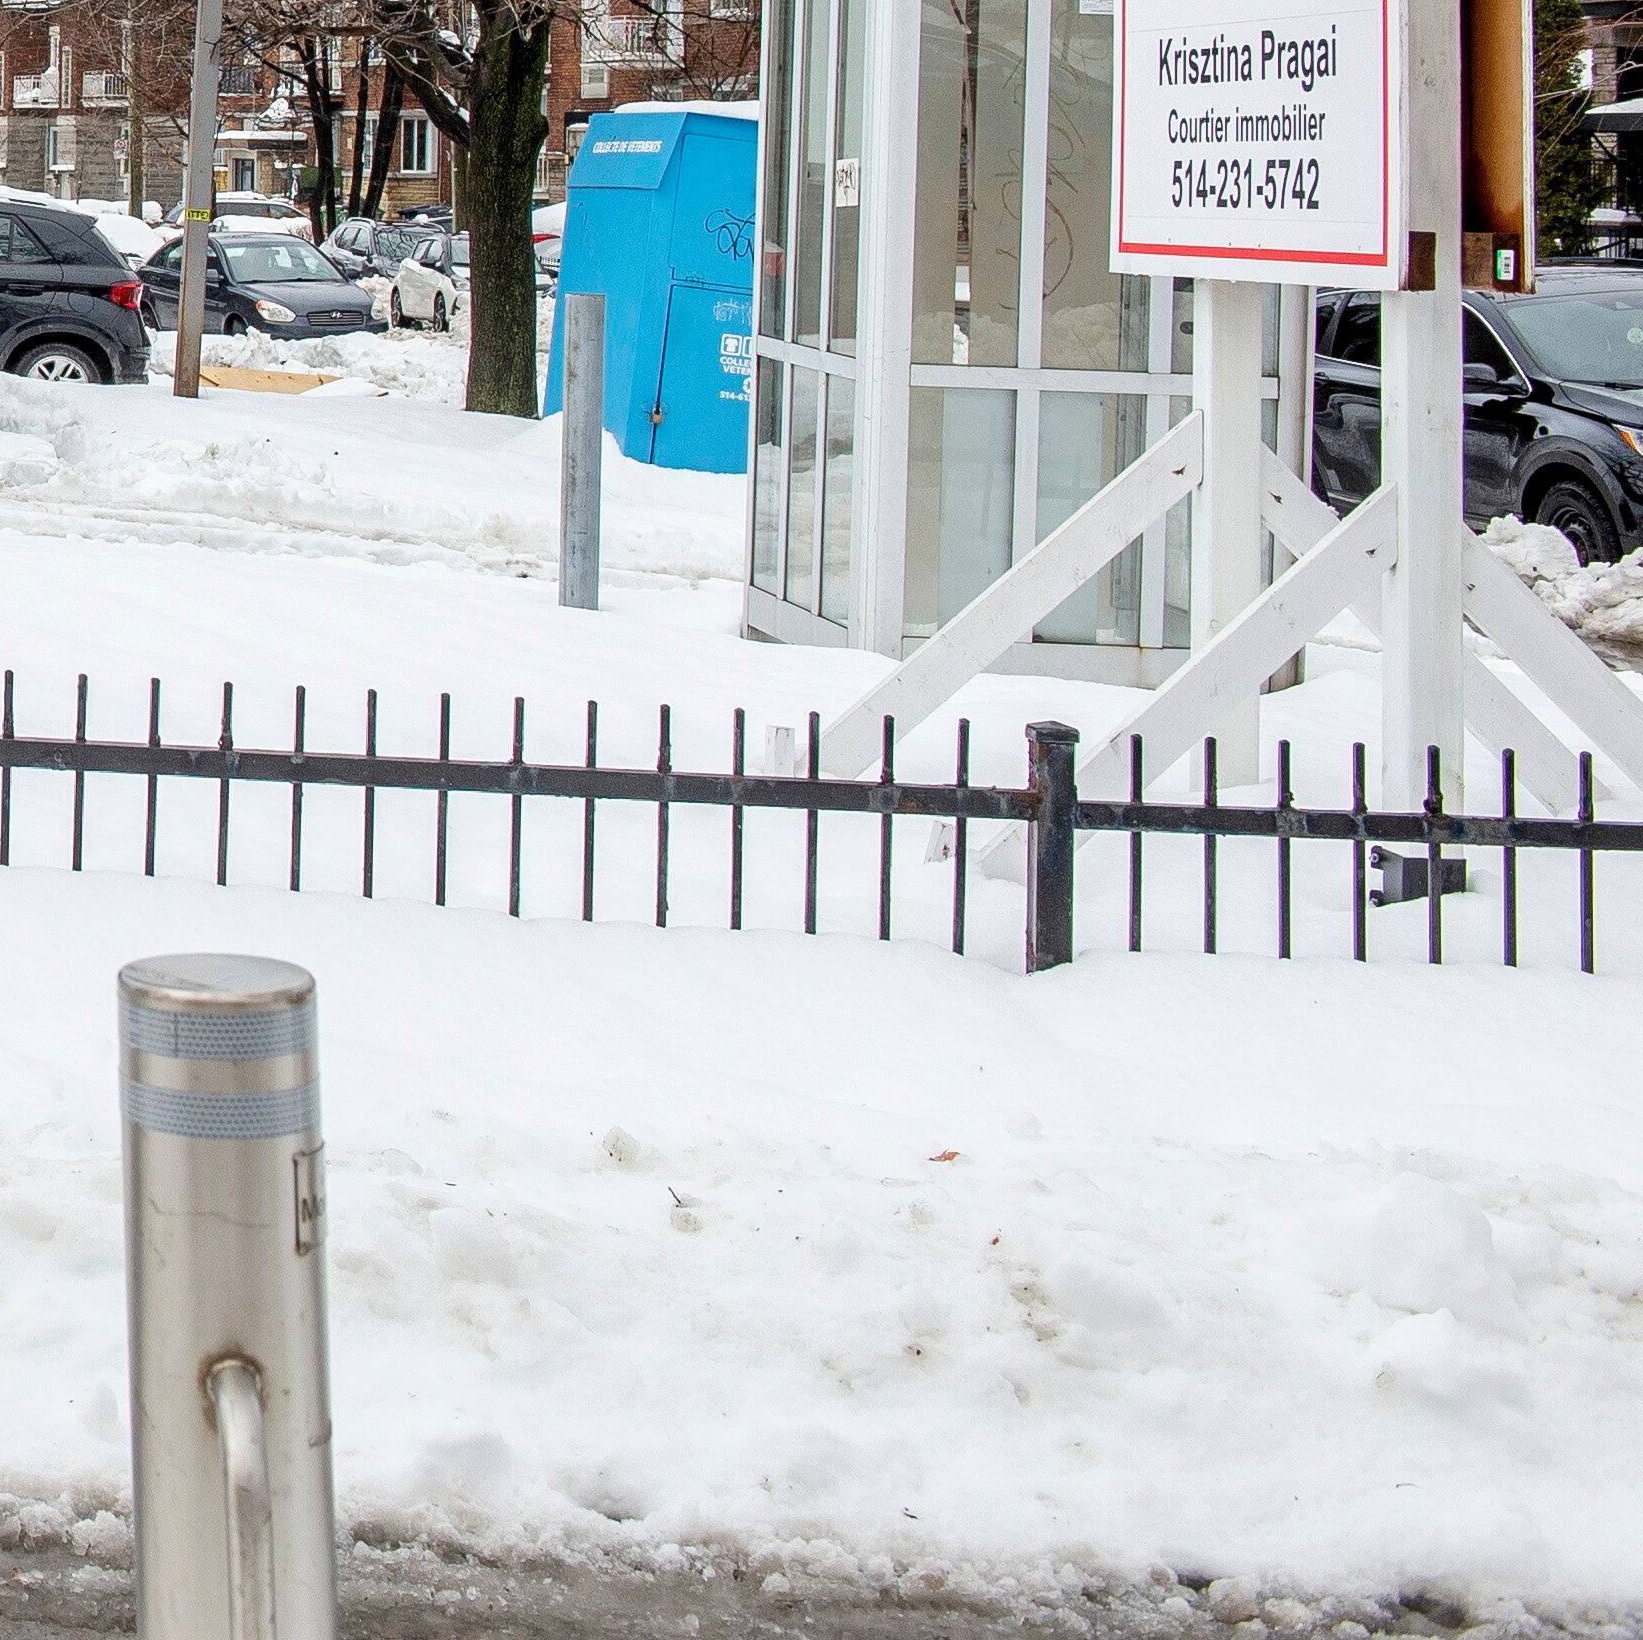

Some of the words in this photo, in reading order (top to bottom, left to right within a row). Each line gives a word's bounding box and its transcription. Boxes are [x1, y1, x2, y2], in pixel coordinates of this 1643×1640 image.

[1159, 33, 1252, 86] Krisztina
[1261, 24, 1337, 92] Pragai
[1168, 106, 1230, 144] Courtier
[1236, 104, 1326, 142] immobilier
[1172, 158, 1319, 210] 514-231-5742
